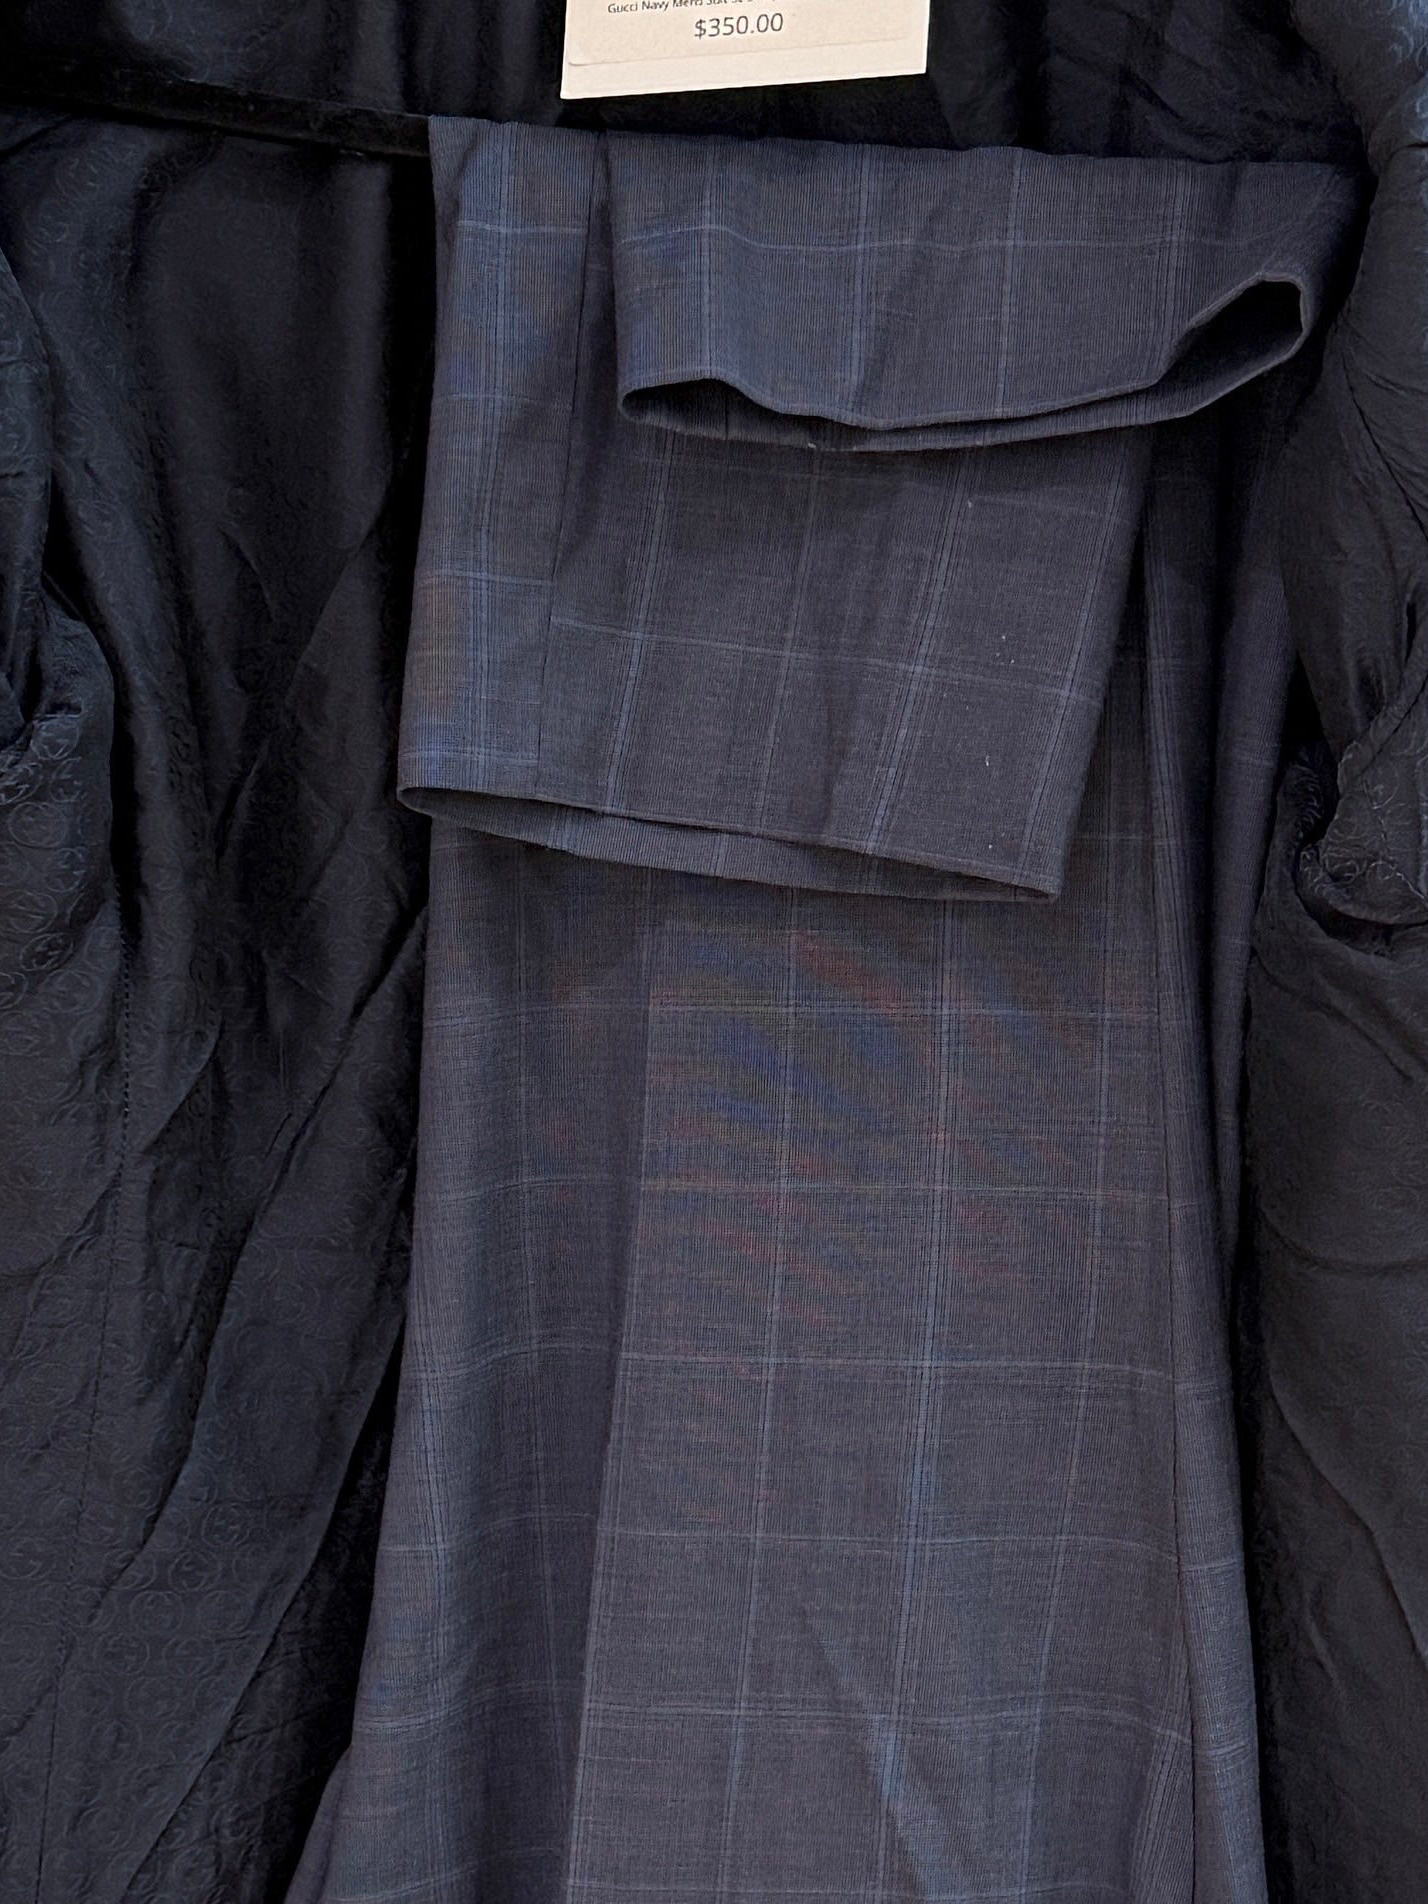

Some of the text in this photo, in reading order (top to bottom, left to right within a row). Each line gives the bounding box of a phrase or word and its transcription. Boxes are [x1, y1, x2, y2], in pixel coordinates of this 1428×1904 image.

[608, 3, 638, 14] Gucci
[642, 0, 669, 11] Navy
[694, 12, 784, 39] $350.00
